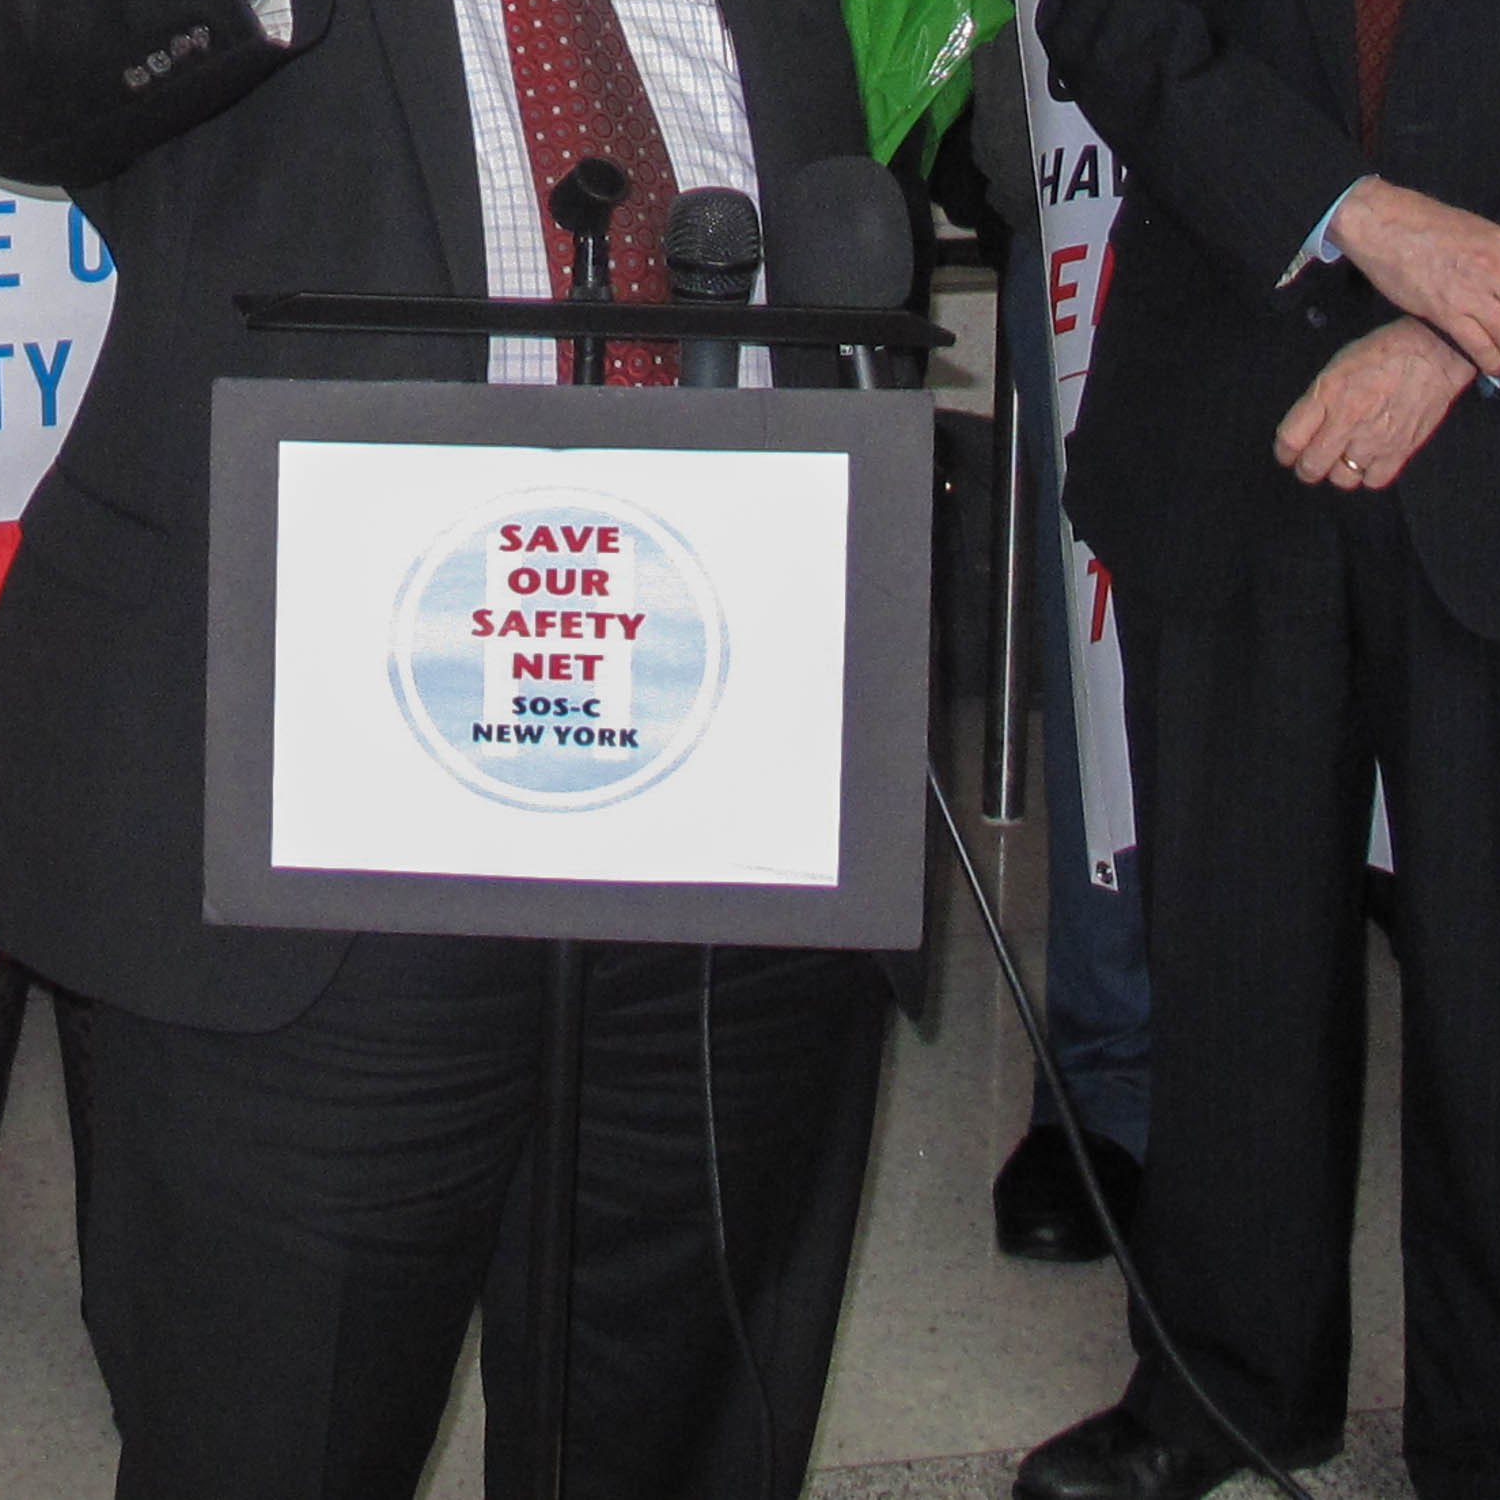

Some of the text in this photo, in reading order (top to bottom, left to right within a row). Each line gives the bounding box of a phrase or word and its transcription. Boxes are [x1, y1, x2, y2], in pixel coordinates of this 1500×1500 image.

[499, 524, 621, 553] SAVE
[508, 567, 610, 596] OUR
[472, 609, 646, 640] SAFETY
[512, 653, 604, 681] NET
[512, 696, 601, 718] SOS-C
[473, 723, 639, 748] NEW YORK
